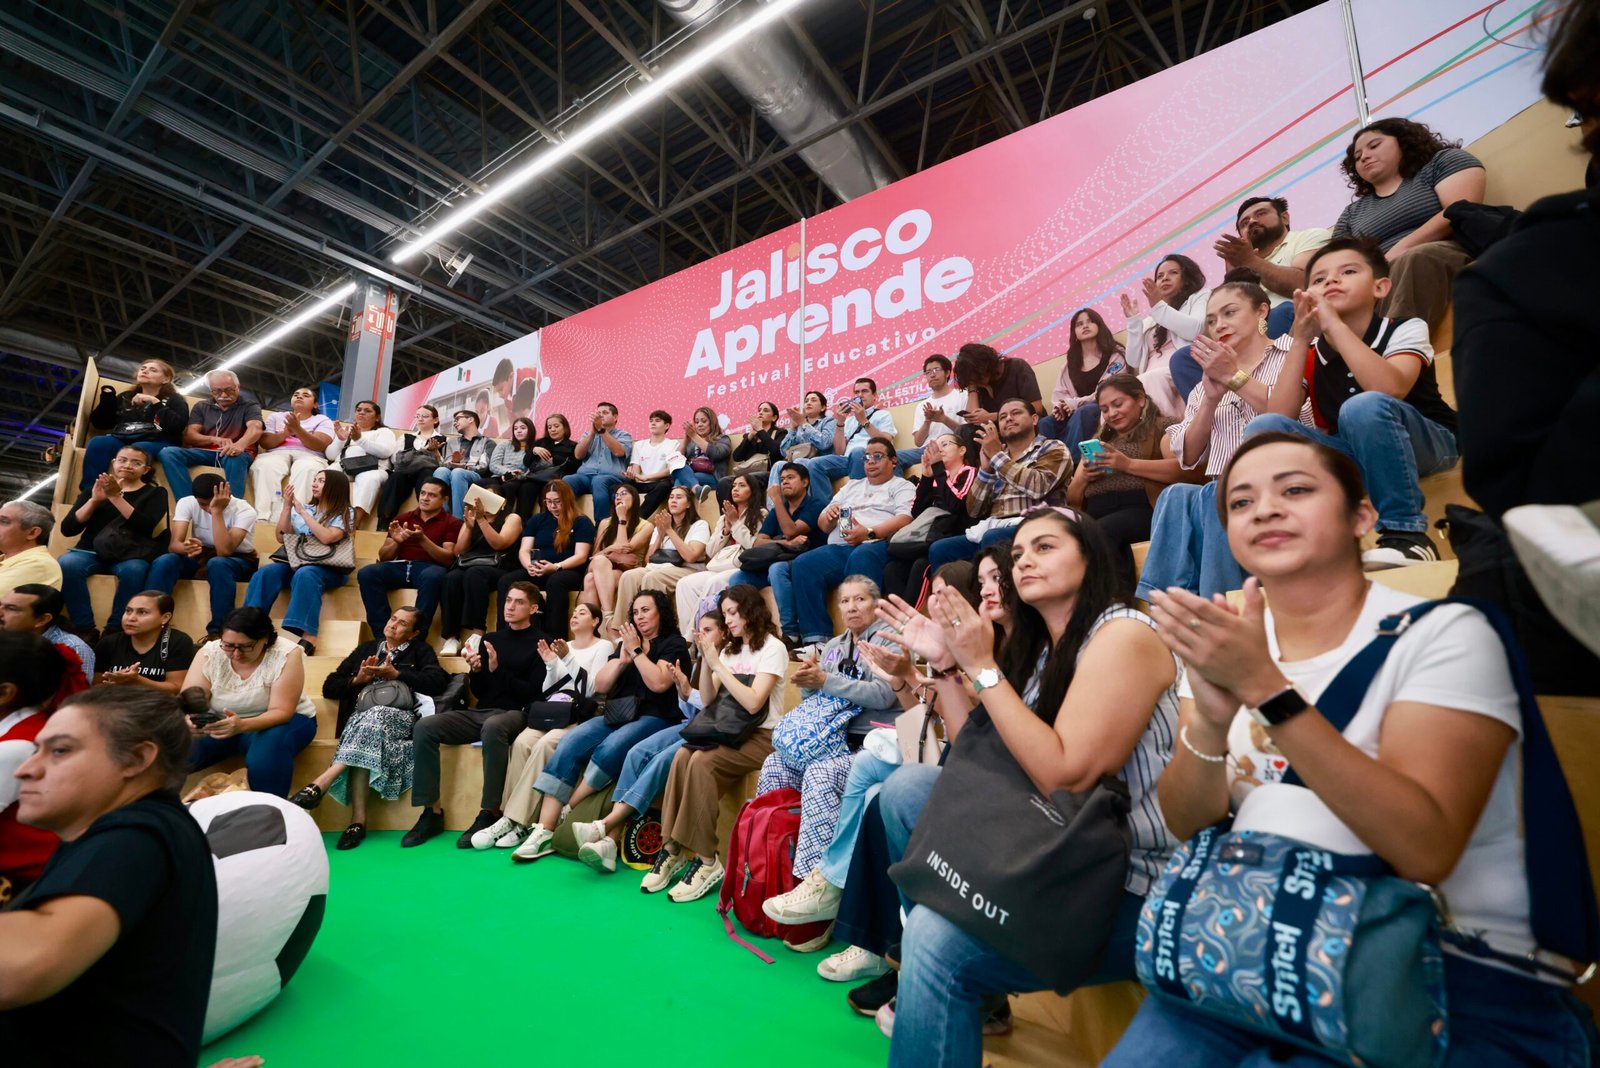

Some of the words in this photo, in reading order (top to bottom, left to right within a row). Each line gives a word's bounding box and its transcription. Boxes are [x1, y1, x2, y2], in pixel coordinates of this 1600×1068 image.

[709, 208, 932, 320] Jalisco
[684, 256, 974, 378] Aprende
[707, 362, 790, 398] Festival
[804, 326, 936, 373] Educativo
[926, 850, 971, 899] INSIDE
[971, 892, 1010, 926] OUT
